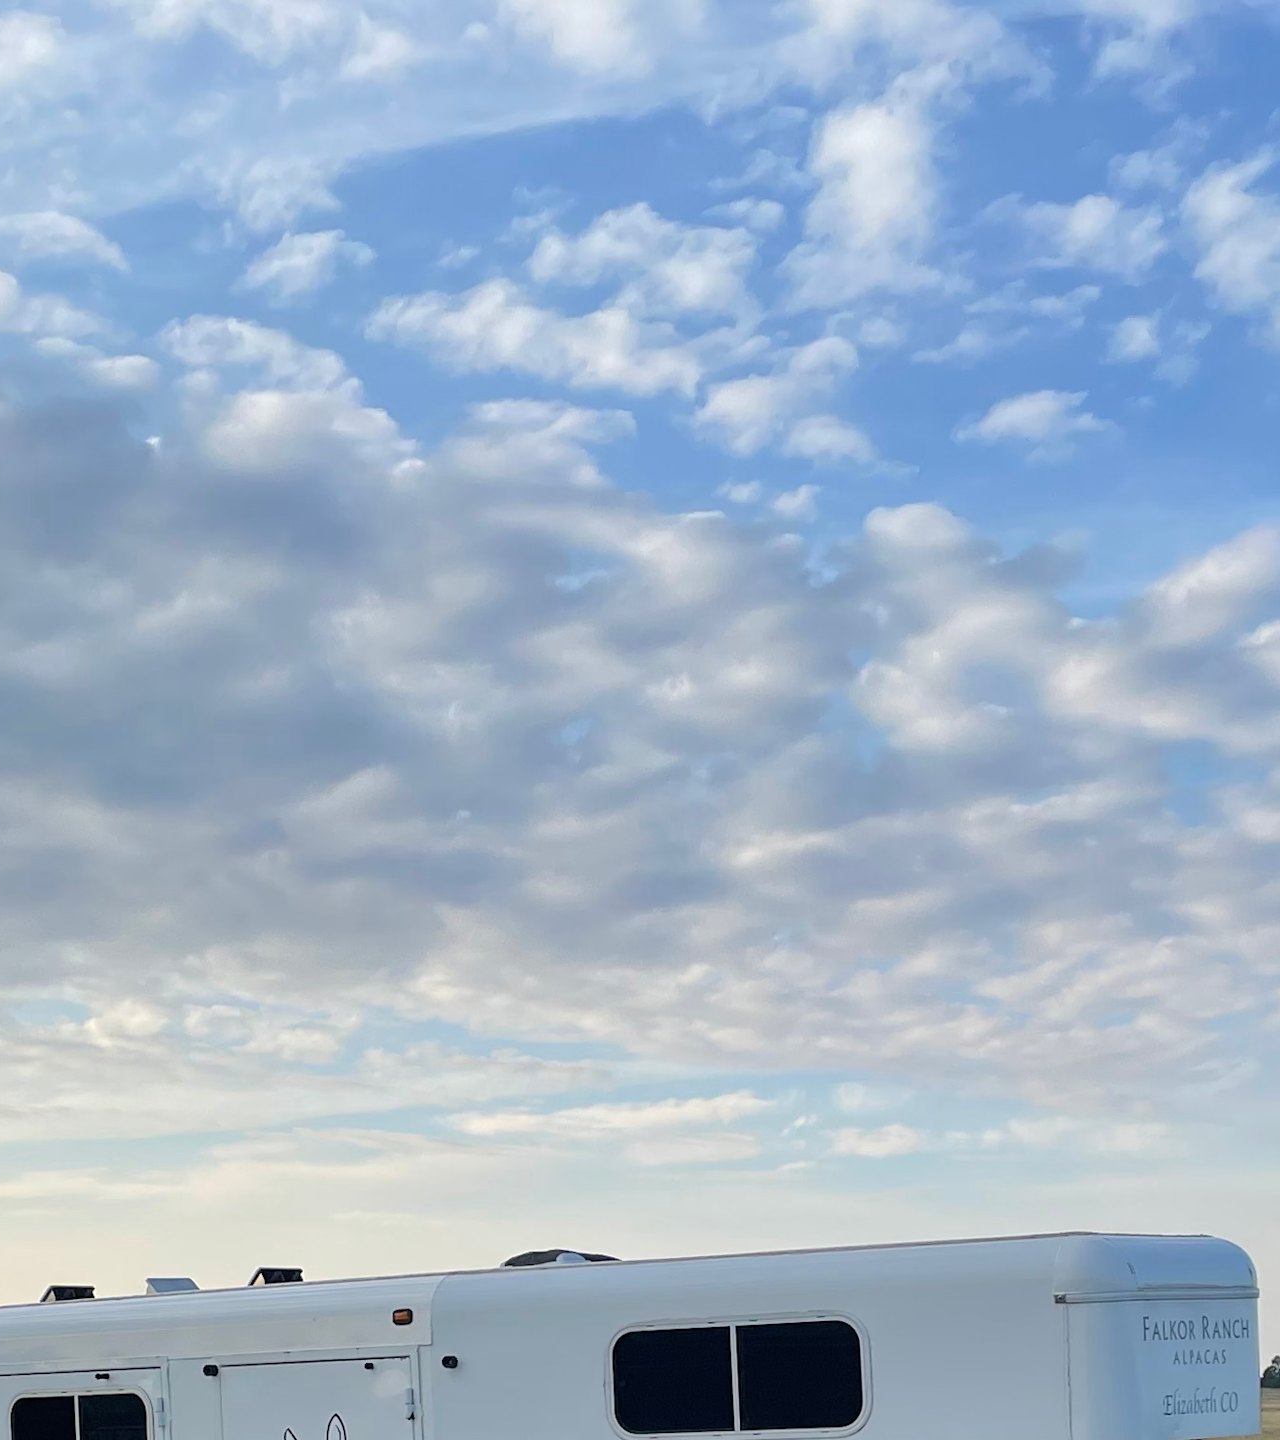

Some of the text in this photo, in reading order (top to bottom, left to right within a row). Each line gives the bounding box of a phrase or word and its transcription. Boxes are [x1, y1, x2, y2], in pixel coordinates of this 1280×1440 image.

[1142, 1315, 1250, 1341] FALKOR RANCH
[1173, 1349, 1227, 1365] ALPACAS
[1162, 1386, 1239, 1416] Elizabeth CO
